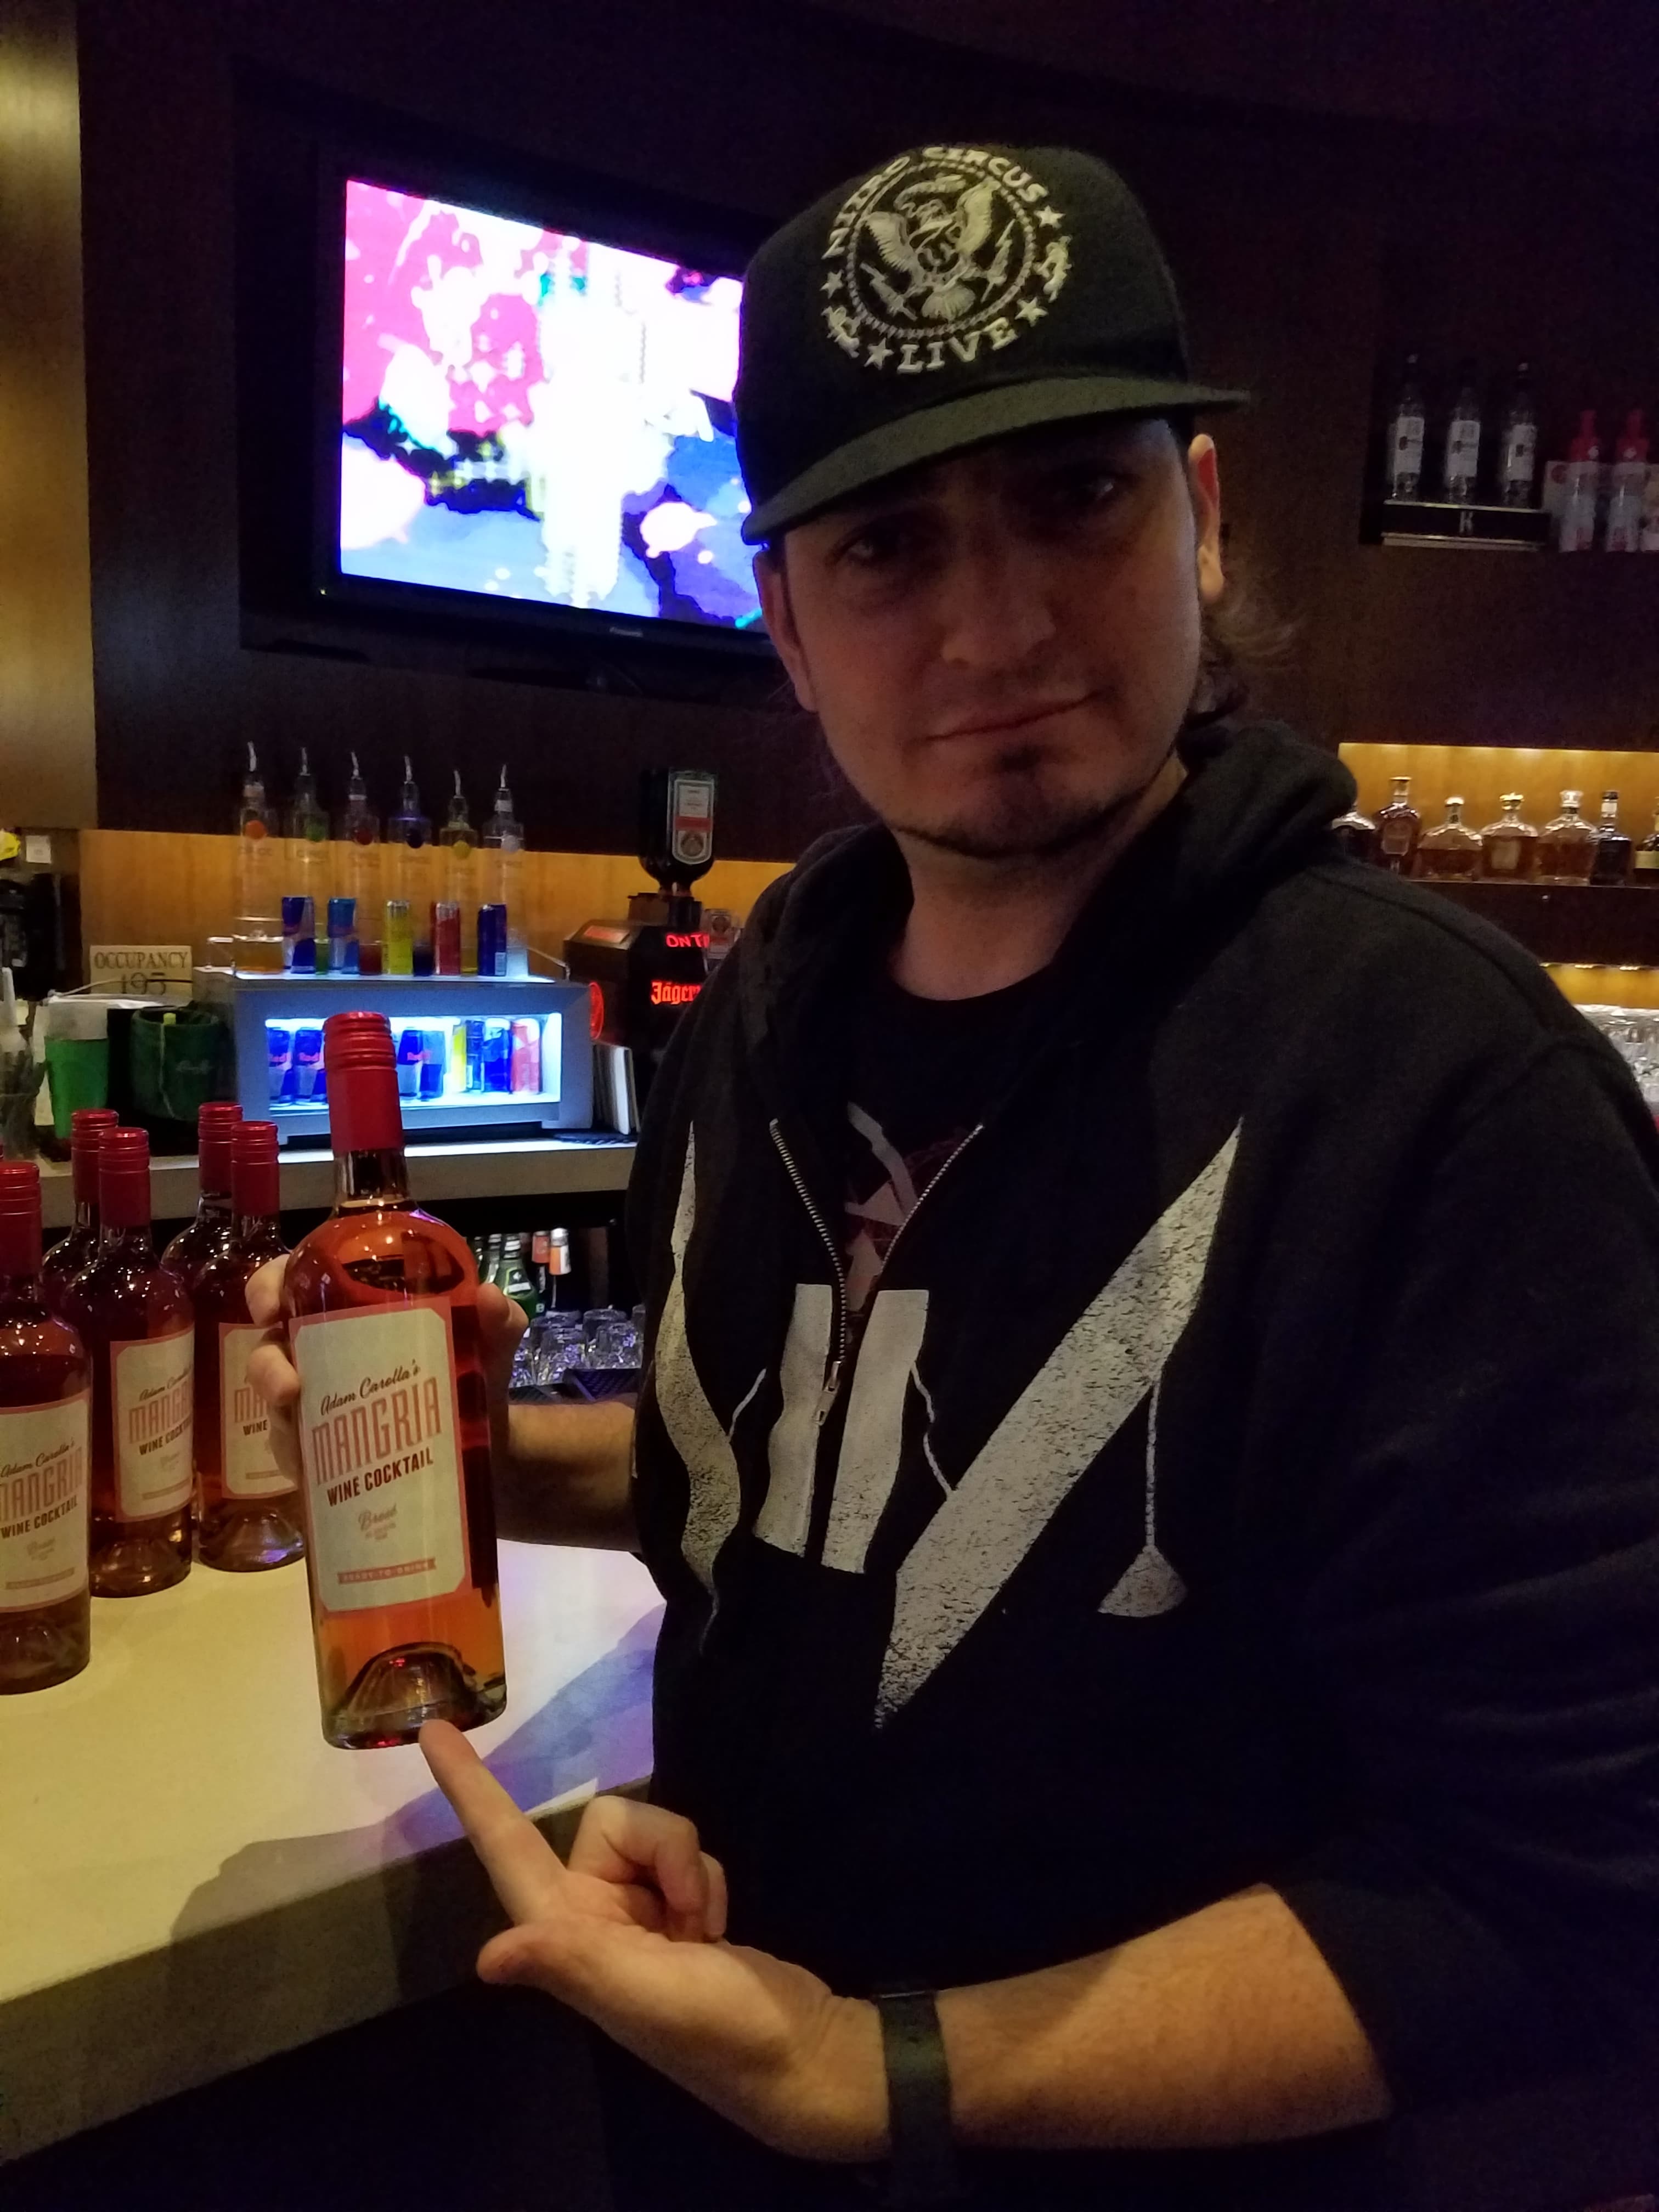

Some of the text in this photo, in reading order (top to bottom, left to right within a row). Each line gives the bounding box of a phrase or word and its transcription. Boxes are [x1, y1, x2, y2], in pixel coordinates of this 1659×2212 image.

[922, 146, 1048, 202] CIRCUS
[897, 317, 1019, 375] LIVE
[94, 951, 188, 969] OCCUPANCY
[120, 972, 167, 995] 195
[320, 1358, 420, 1416] Adam Carolla's
[139, 1436, 163, 1455] WINE
[242, 1419, 267, 1436] WINE
[311, 1376, 442, 1486] MANGRIA
[1, 1463, 33, 1478] Adam
[326, 1447, 433, 1507] WINE COCKTAIL
[1, 1494, 78, 1538] WINE COCKTAIL
